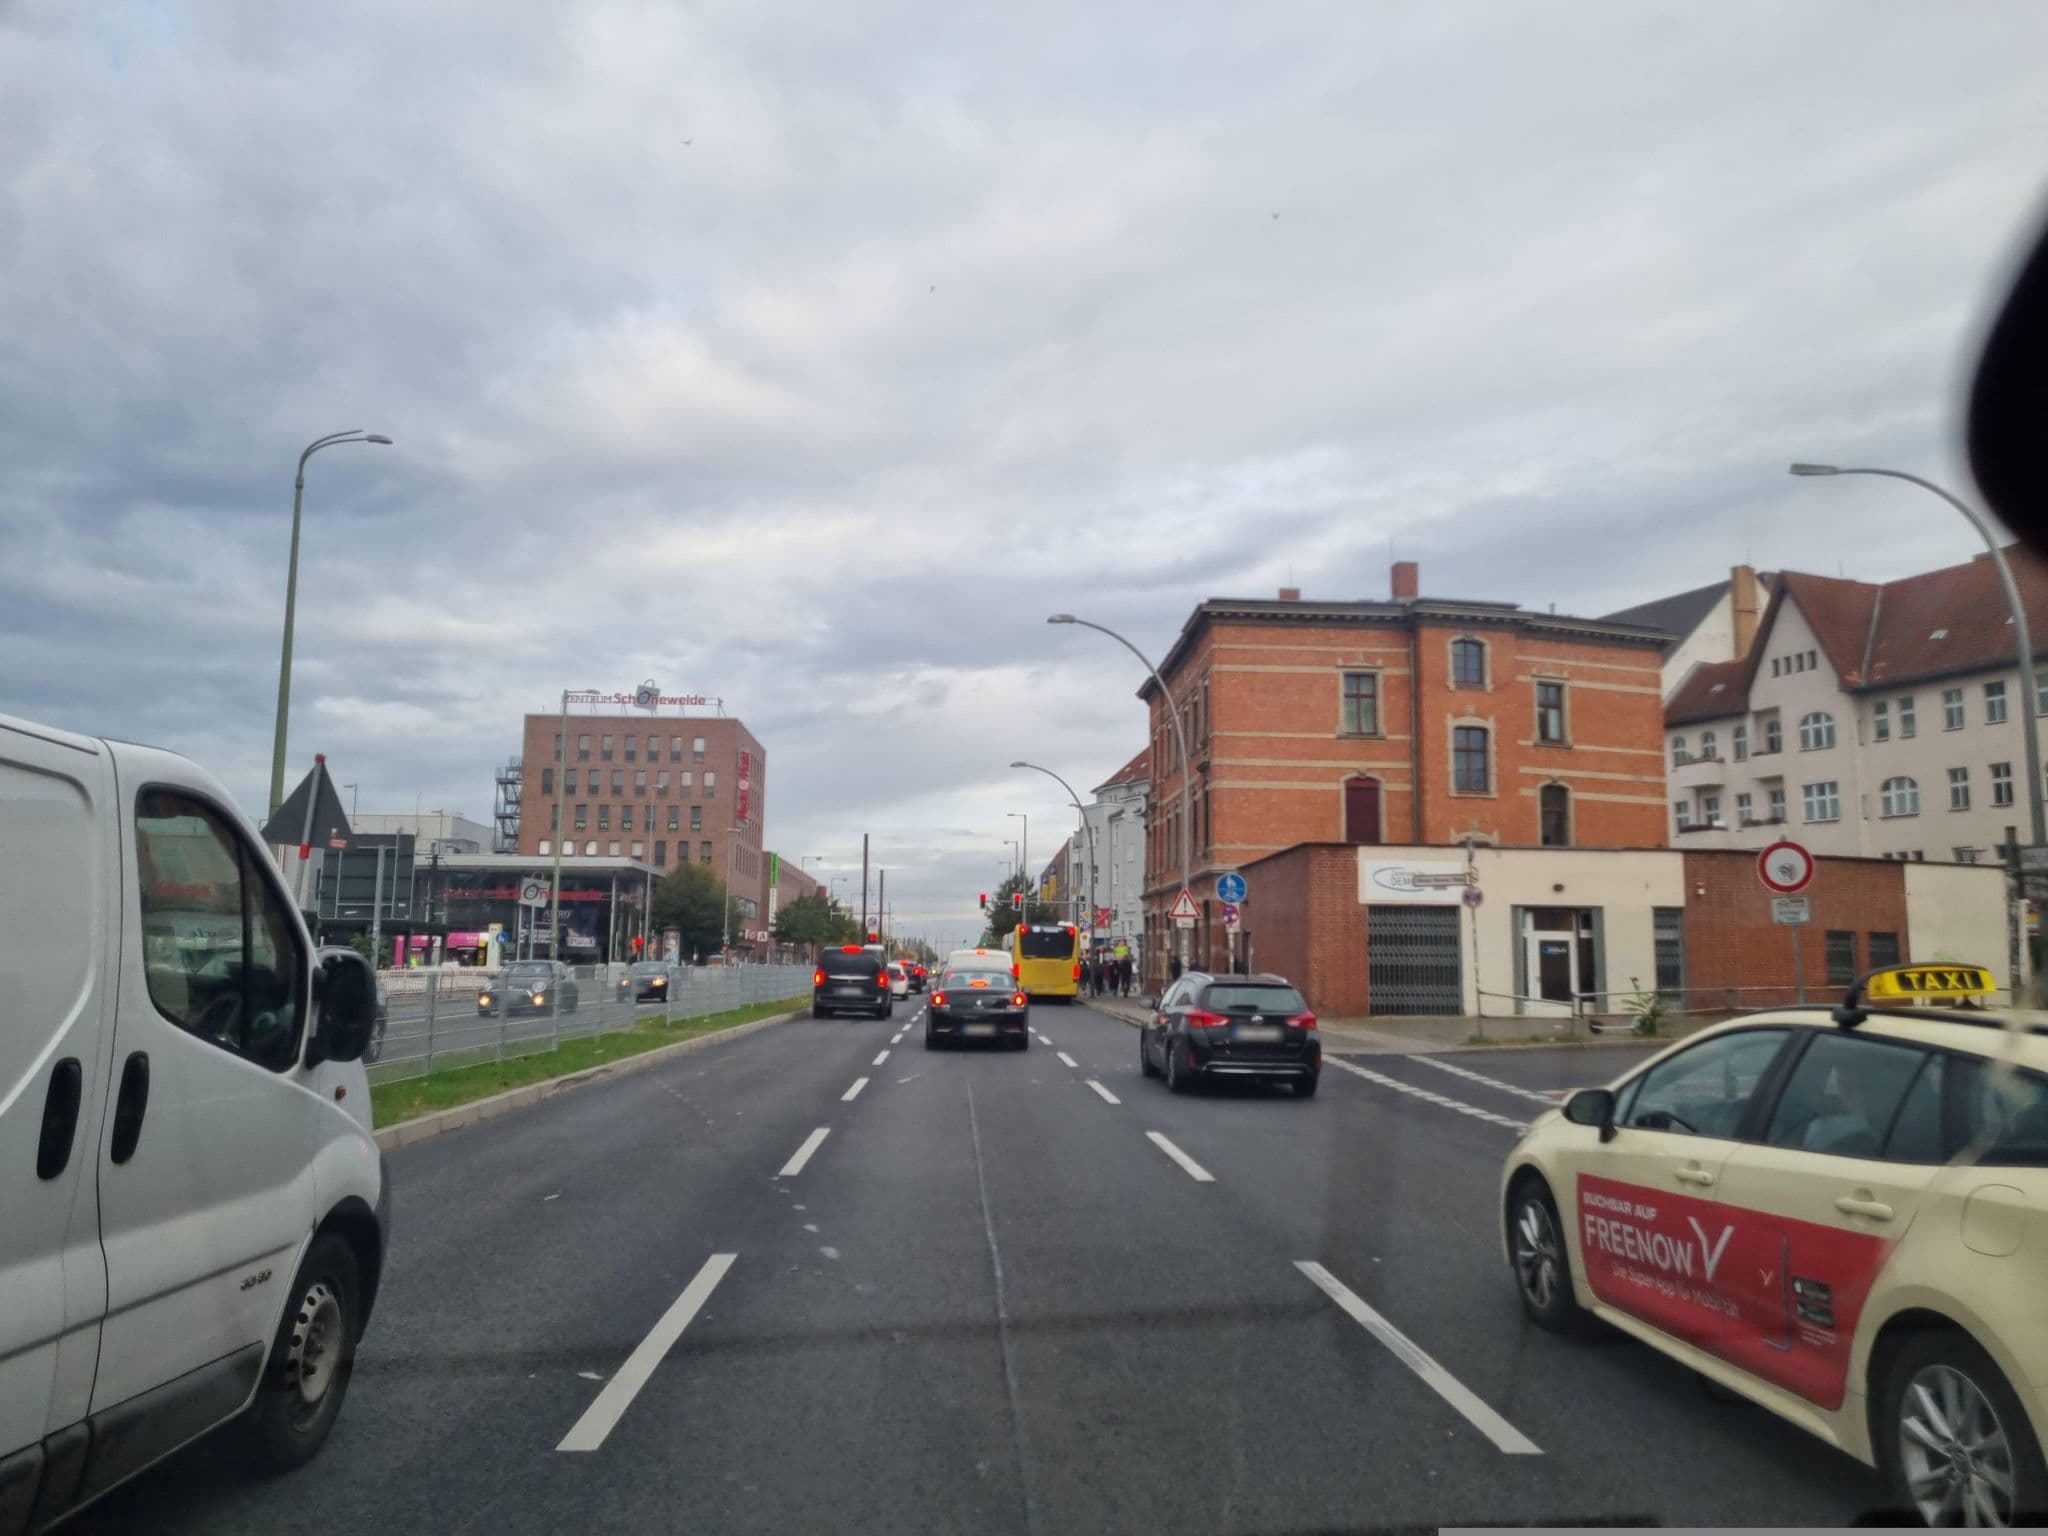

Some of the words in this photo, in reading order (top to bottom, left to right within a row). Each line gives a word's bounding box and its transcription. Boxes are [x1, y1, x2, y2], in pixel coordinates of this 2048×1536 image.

[1905, 972, 1972, 990] TAXI
[1635, 1204, 1657, 1220] AUF
[1584, 1213, 1693, 1278] FREENOW
